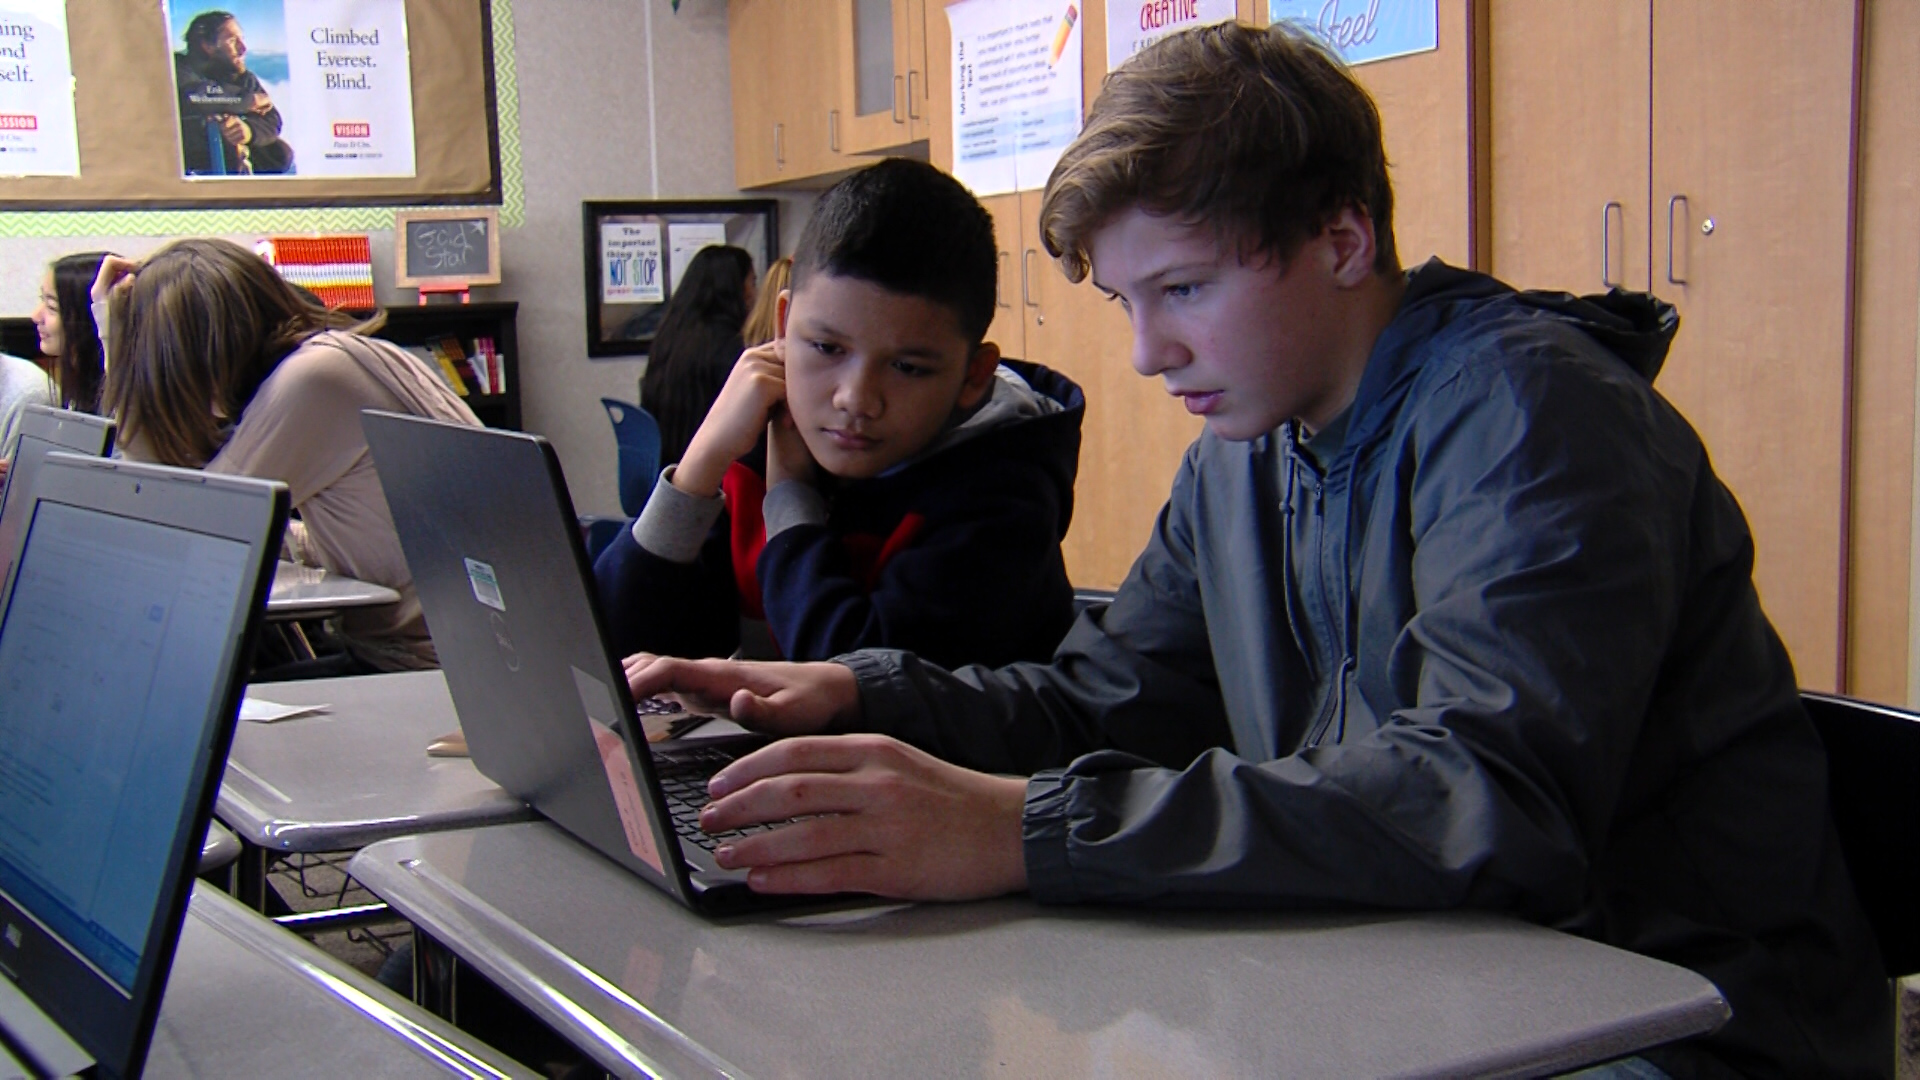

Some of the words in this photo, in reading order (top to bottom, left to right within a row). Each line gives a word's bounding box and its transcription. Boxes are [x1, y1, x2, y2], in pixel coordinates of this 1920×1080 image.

[1140, 0, 1198, 31] CREATIVE
[1317, 0, 1380, 49] Feel
[310, 27, 379, 46] Climbed
[317, 50, 377, 68] Everest.
[325, 73, 372, 90] Blind.
[335, 125, 369, 136] VISION
[622, 227, 641, 236] The
[608, 239, 656, 249] important
[606, 250, 632, 260] thing
[610, 258, 627, 286] NOT
[633, 257, 657, 286] STOP
